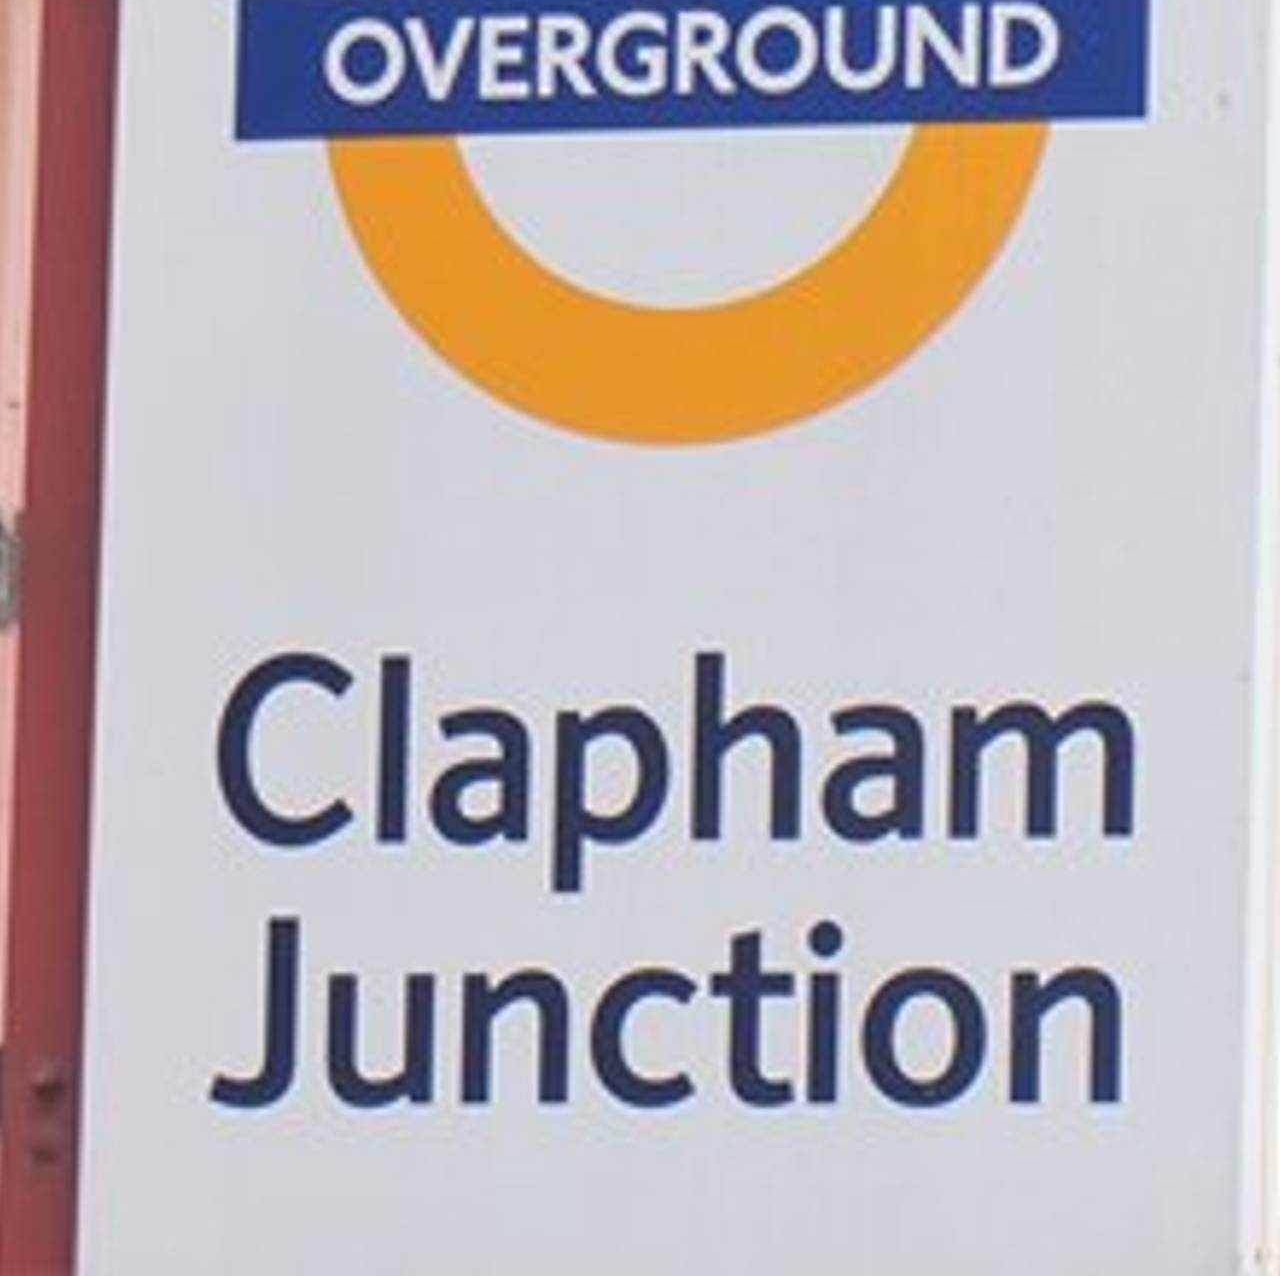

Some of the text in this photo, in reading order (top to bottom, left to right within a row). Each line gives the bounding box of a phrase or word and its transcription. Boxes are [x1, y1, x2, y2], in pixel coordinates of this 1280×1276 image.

[324, 0, 1060, 105] OVERGROUND
[216, 651, 1135, 894] Clapham
[209, 916, 1122, 1110] Junction
